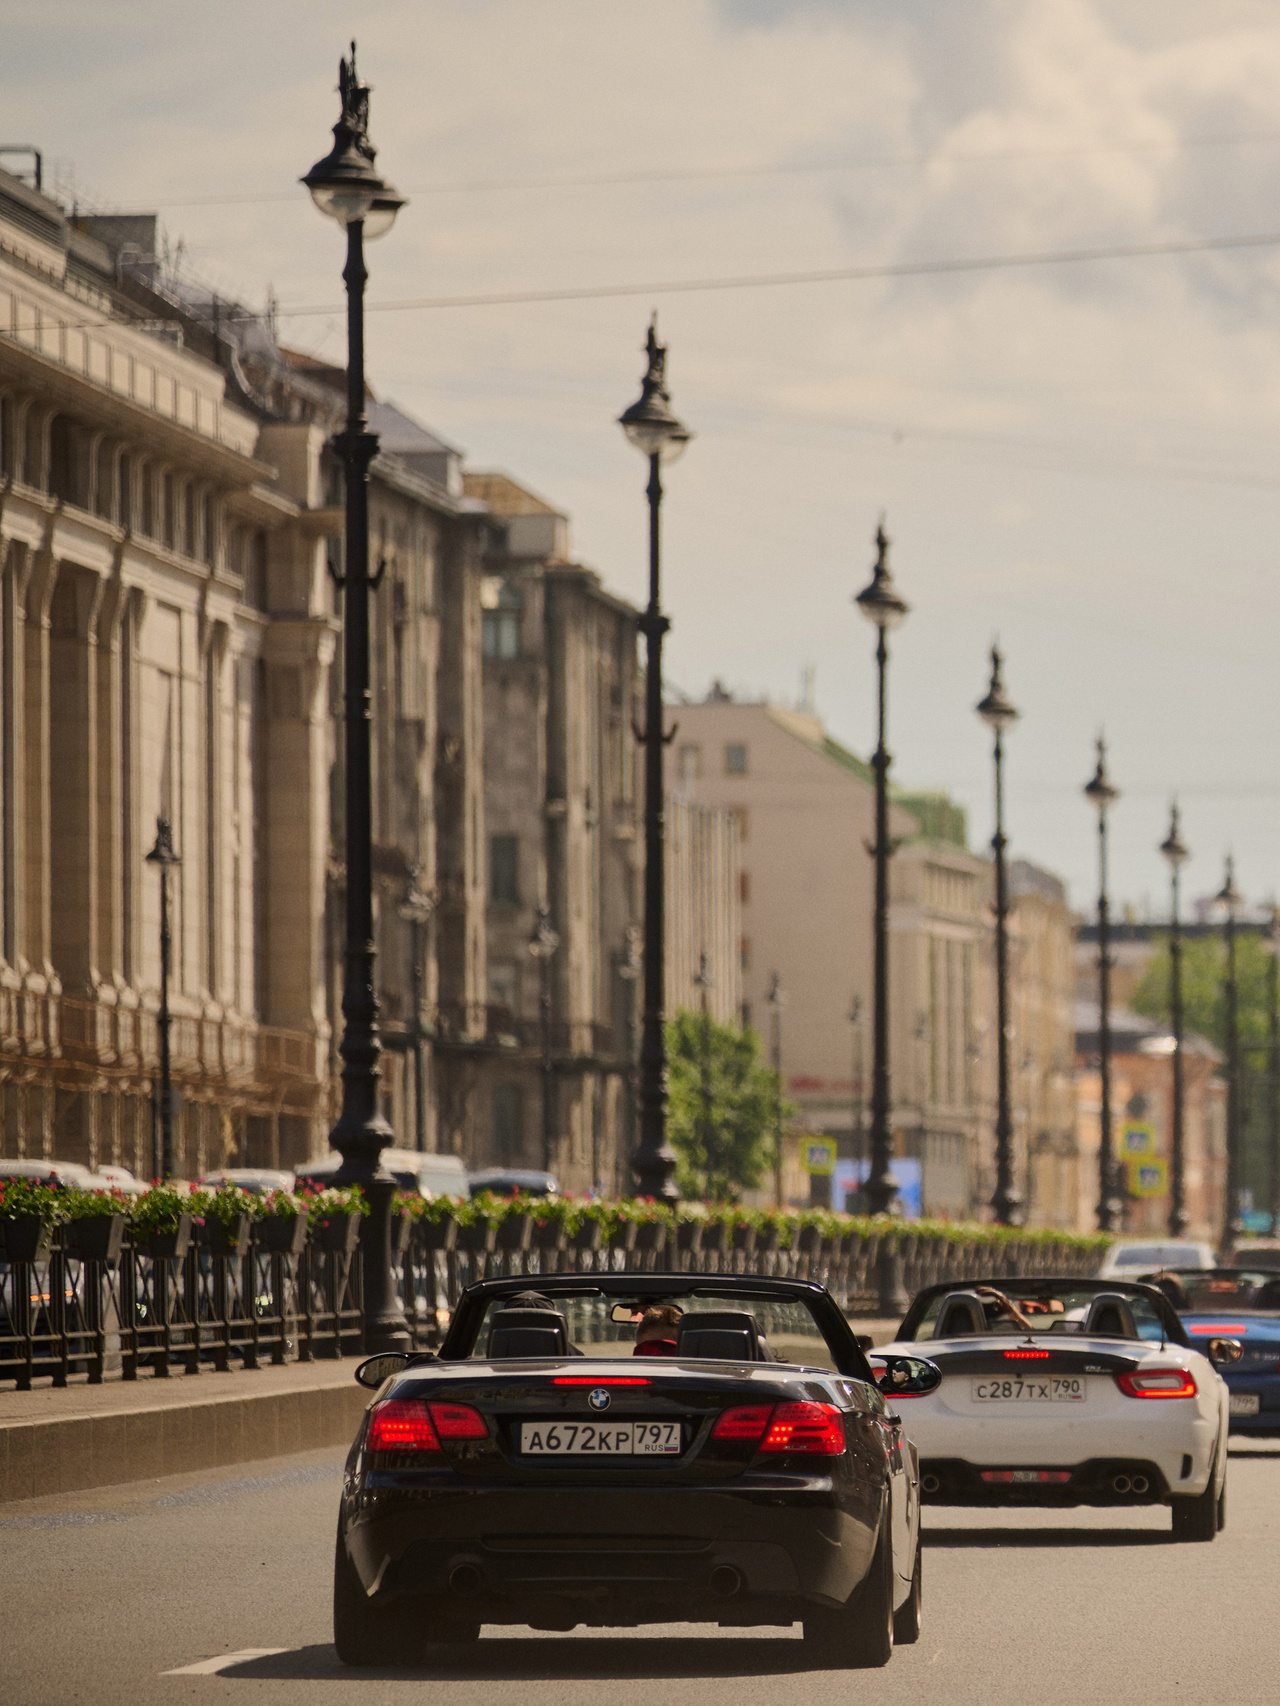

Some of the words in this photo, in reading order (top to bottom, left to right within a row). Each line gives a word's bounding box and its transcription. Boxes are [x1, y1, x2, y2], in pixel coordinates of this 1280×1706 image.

[1053, 1380, 1080, 1393] 790
[636, 1425, 675, 1444] 797
[645, 1444, 664, 1452] RUS
